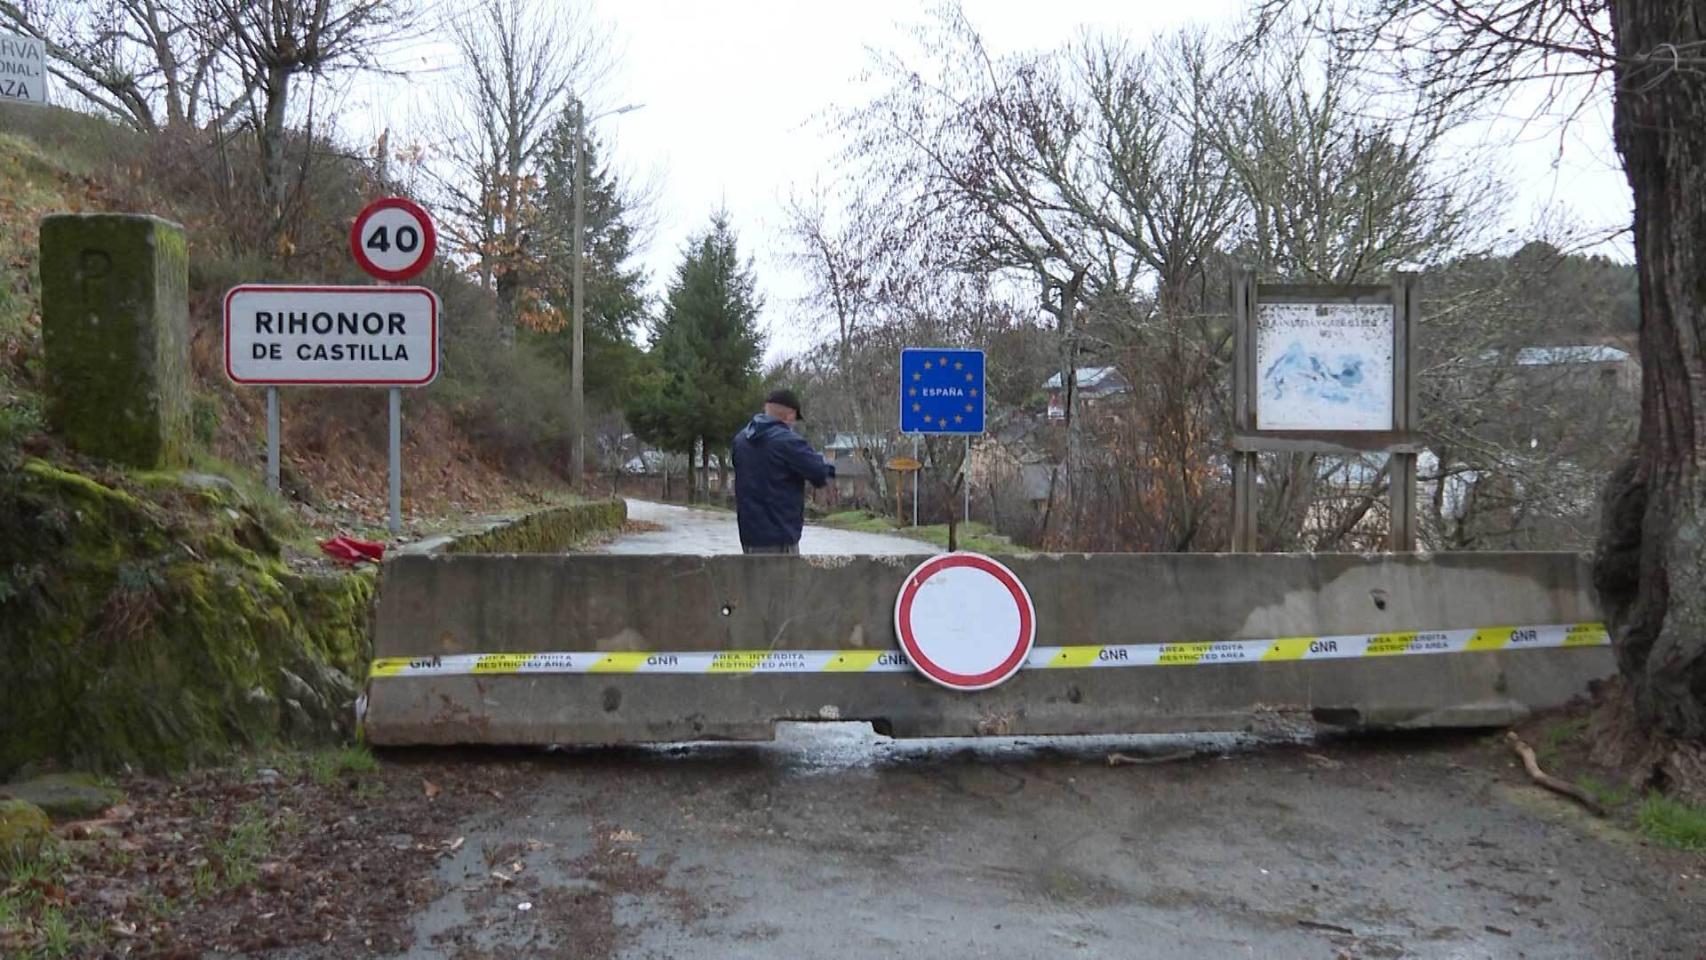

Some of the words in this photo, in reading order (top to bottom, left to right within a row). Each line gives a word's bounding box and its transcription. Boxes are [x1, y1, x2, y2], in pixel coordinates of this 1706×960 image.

[366, 225, 419, 253] 40
[255, 311, 407, 335] RIHONOR
[252, 343, 282, 360] DE
[296, 344, 409, 361] CASTILLA
[922, 387, 964, 397] ESPAÑA
[1510, 628, 1537, 643] GNR
[1309, 640, 1338, 653] GNR
[647, 656, 678, 666] GNR
[877, 655, 908, 665] GNR
[1099, 648, 1128, 662] GNR
[1160, 653, 1218, 661] RESTRICTED
